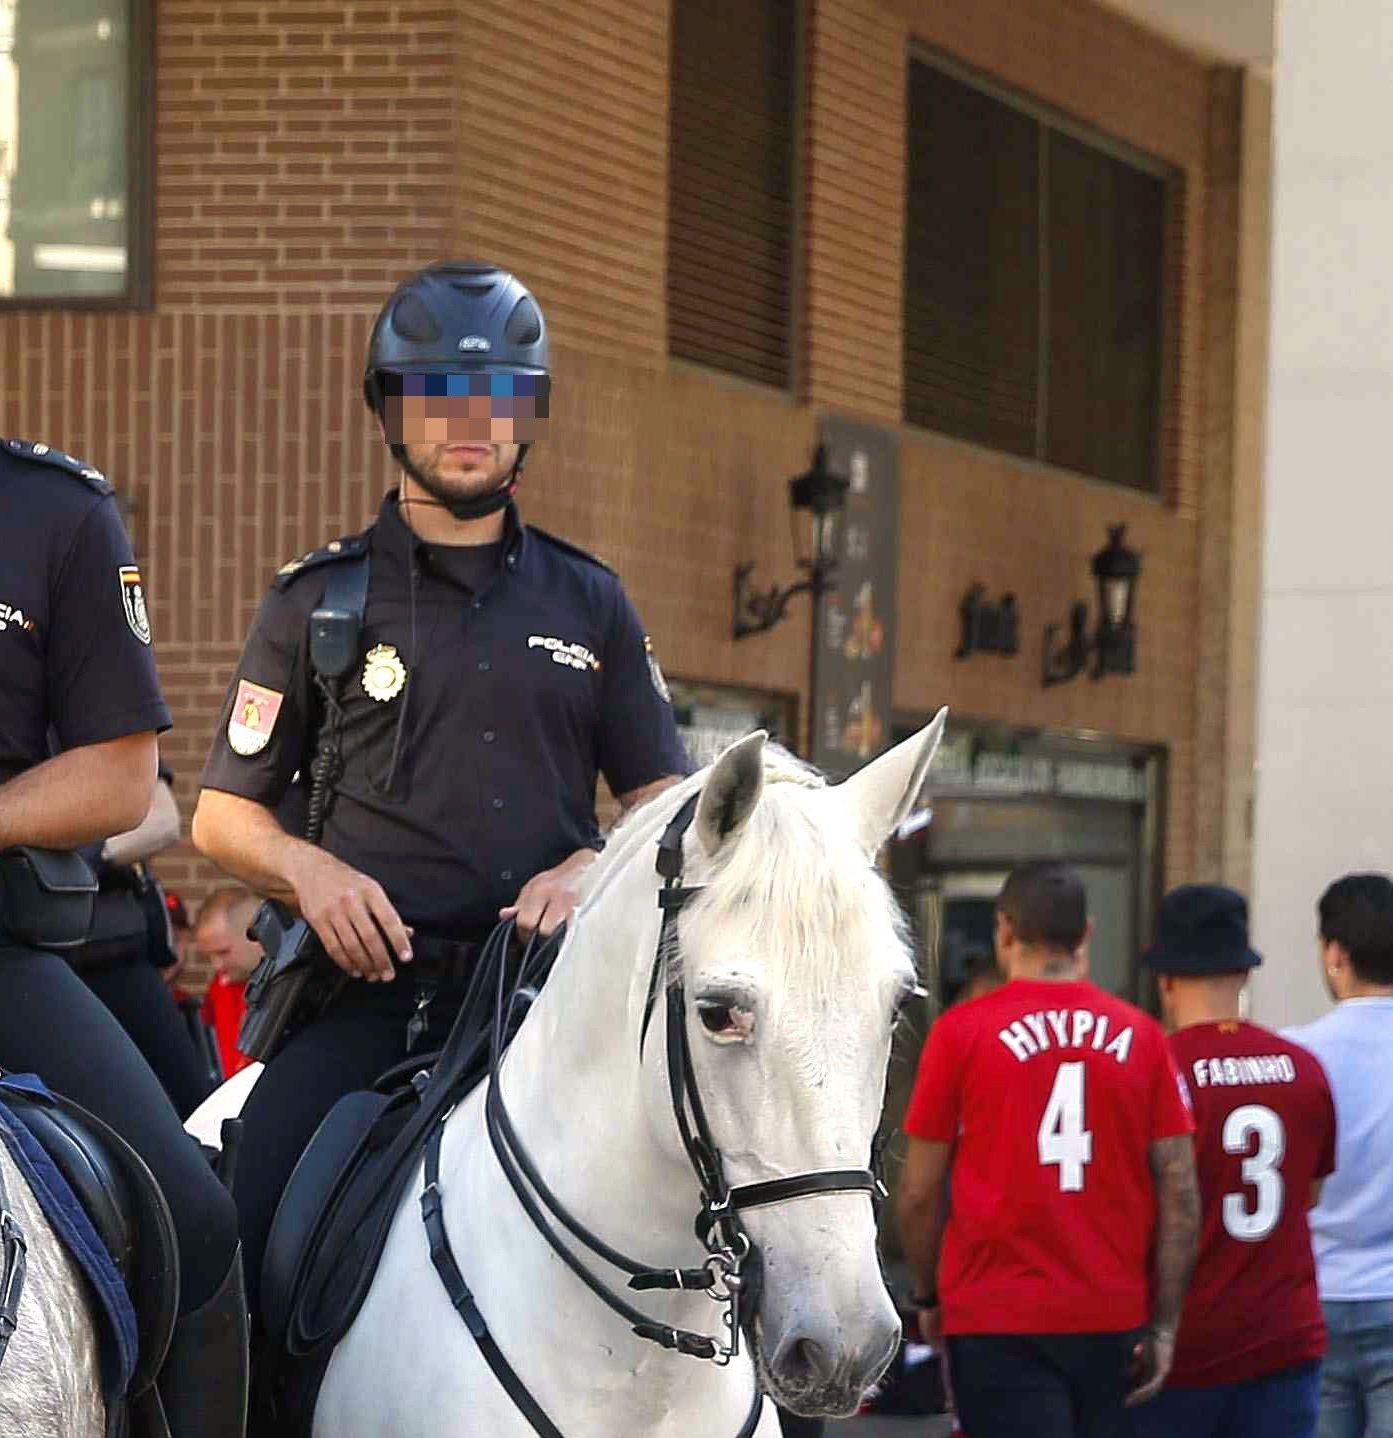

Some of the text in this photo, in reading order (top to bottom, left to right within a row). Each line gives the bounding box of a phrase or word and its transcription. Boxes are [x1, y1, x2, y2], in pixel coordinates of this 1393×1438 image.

[998, 1008, 1134, 1063] HYYPIA
[1038, 1061, 1093, 1193] 4
[1221, 1103, 1287, 1242] 3
